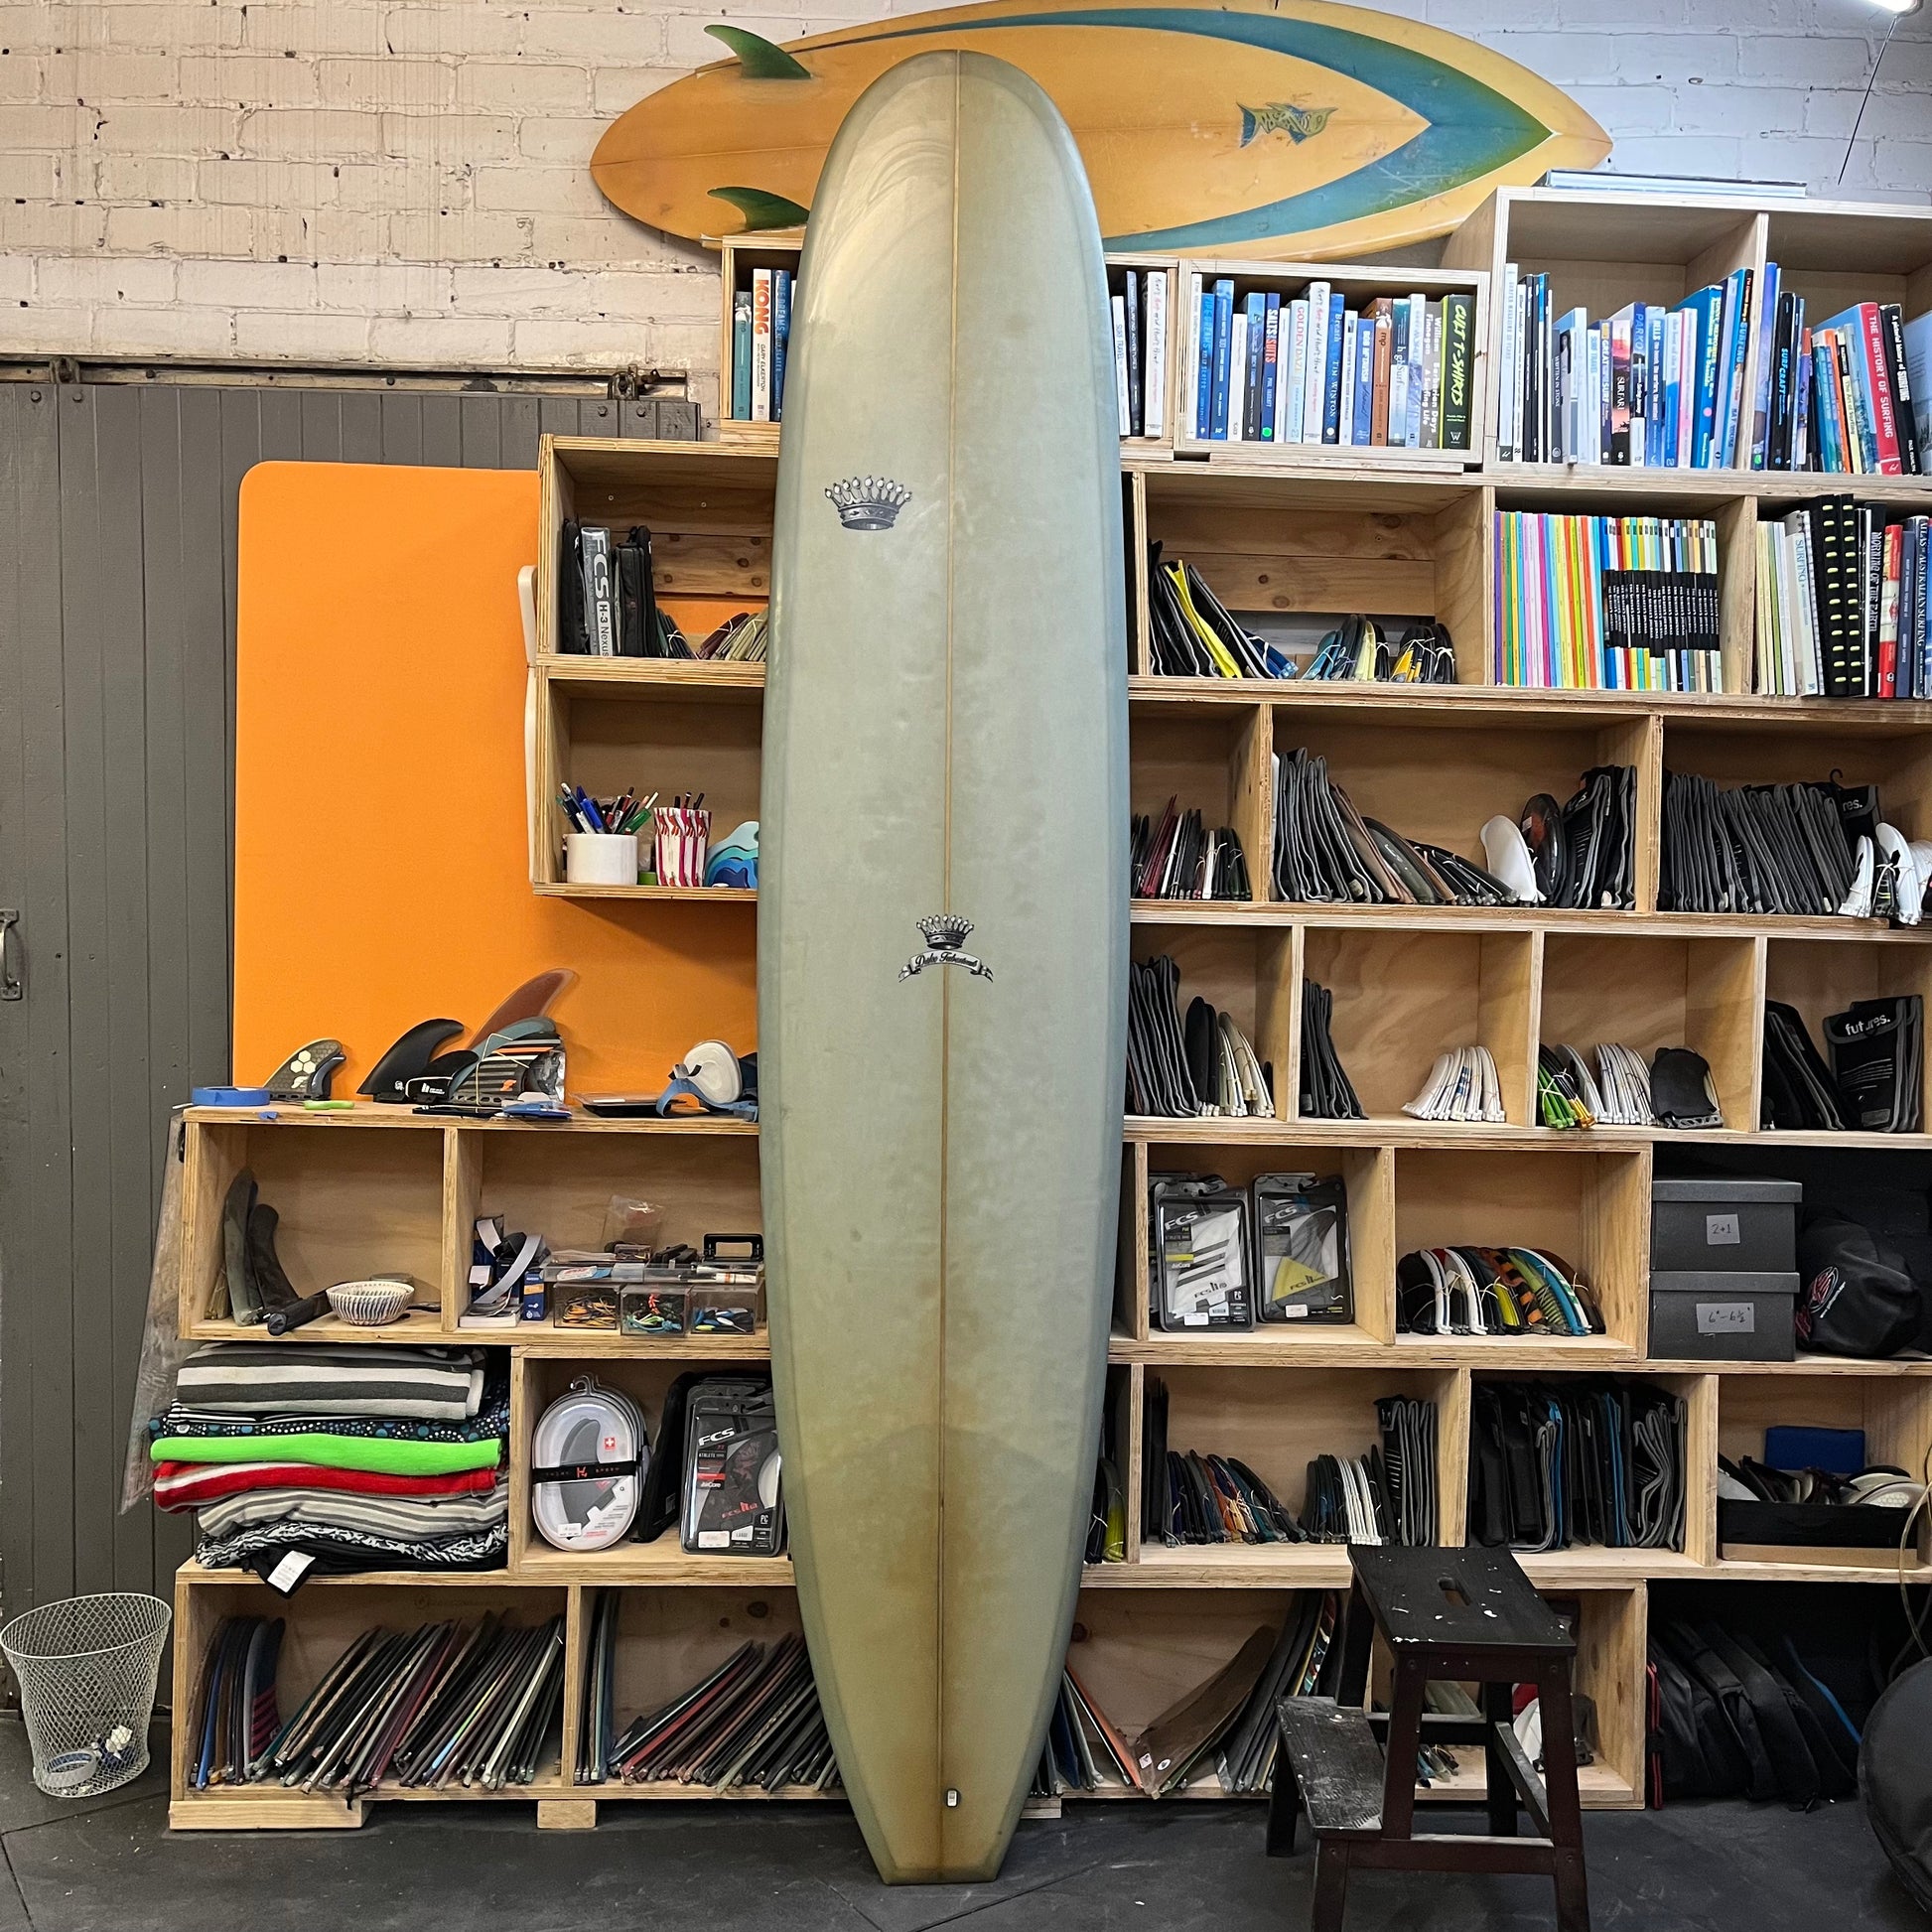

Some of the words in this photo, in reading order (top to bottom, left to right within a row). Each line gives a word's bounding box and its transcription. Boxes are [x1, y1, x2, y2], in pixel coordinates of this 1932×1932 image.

[755, 279, 769, 336] KONG
[1266, 309, 1278, 335] SALTS
[1453, 304, 1466, 340] CULT
[1296, 306, 1305, 346] GOLDEN
[1333, 314, 1342, 342] Breath
[1379, 332, 1386, 345] mp
[1424, 314, 1434, 355] Finnegan
[1635, 314, 1644, 349] PARKO
[1868, 316, 1878, 334] THE
[1890, 322, 1902, 343] pictorial
[1265, 339, 1277, 363] SUITS
[1735, 322, 1747, 363] SURFING
[1871, 338, 1884, 377] HISTORY
[1894, 344, 1903, 362] history
[1432, 362, 1441, 407] Barbarian
[1451, 342, 1465, 407] T-SHIRTS
[1878, 381, 1888, 393] OF
[1896, 370, 1910, 401] SURFING
[1329, 377, 1338, 417] WINTON
[1422, 377, 1431, 407] Surfing
[1430, 410, 1439, 433] Days
[1879, 397, 1893, 439] SURFING
[592, 531, 610, 599] FCS
[1795, 540, 1806, 582] SURFING
[1870, 532, 1882, 570] MORNING
[1870, 573, 1880, 584] OF
[1870, 586, 1879, 600] THE
[1918, 554, 1927, 609] AUSTRALIAN
[599, 605, 608, 623] H-3
[1868, 604, 1878, 631] EARTH
[1916, 610, 1926, 646] SURFING
[600, 626, 610, 657] Nexus
[1845, 1015, 1890, 1035] futures.
[1165, 1211, 1198, 1230] FCS
[1264, 1205, 1298, 1223] FCS
[698, 1428, 735, 1446] FCS
